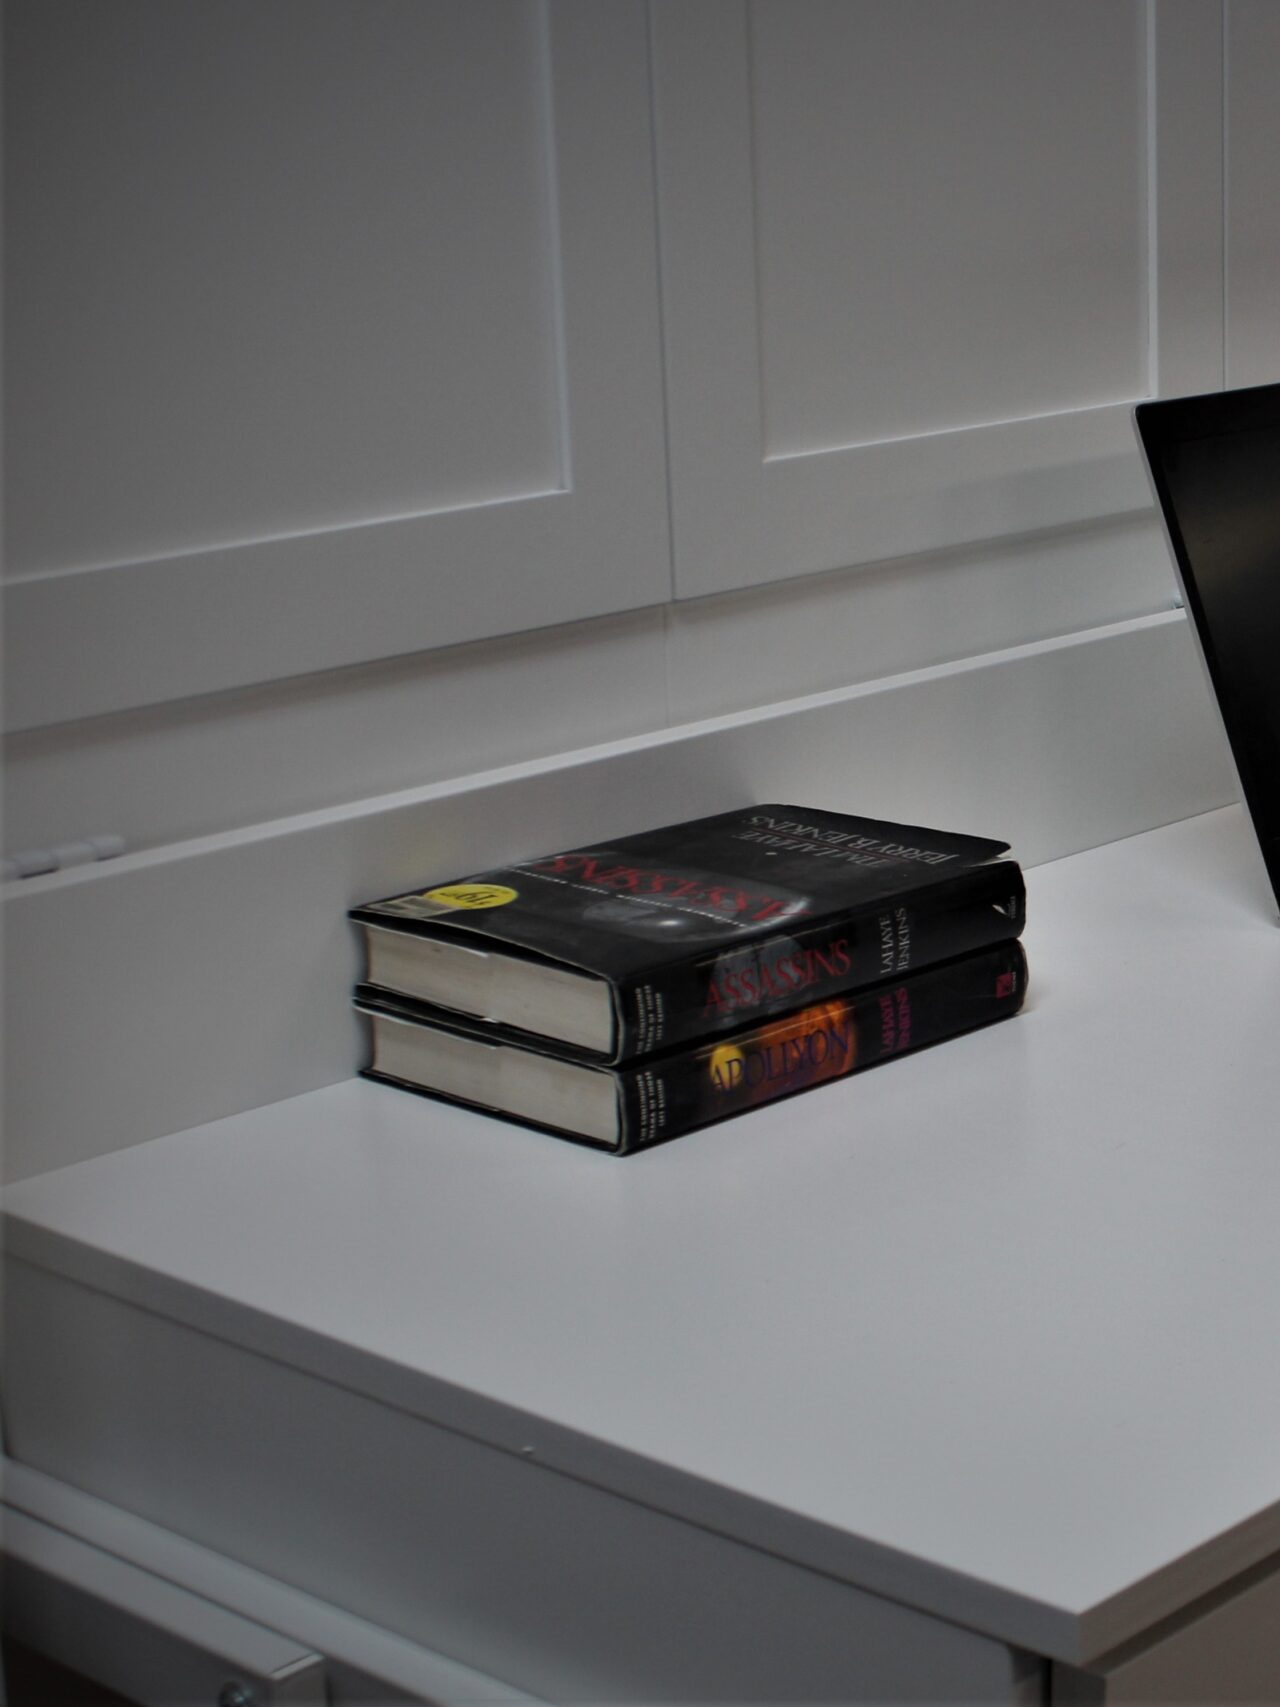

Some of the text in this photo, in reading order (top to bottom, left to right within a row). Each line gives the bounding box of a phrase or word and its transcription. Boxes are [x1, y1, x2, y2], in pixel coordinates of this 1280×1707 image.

[750, 815, 862, 844] JENKINS
[874, 843, 960, 865] JERRY
[533, 856, 813, 921] ASSASSINS
[880, 914, 895, 975] LAHAYE
[896, 907, 911, 972] JENKINS
[702, 938, 852, 1019] ASSASSINS
[712, 1018, 851, 1096] APOLLYON
